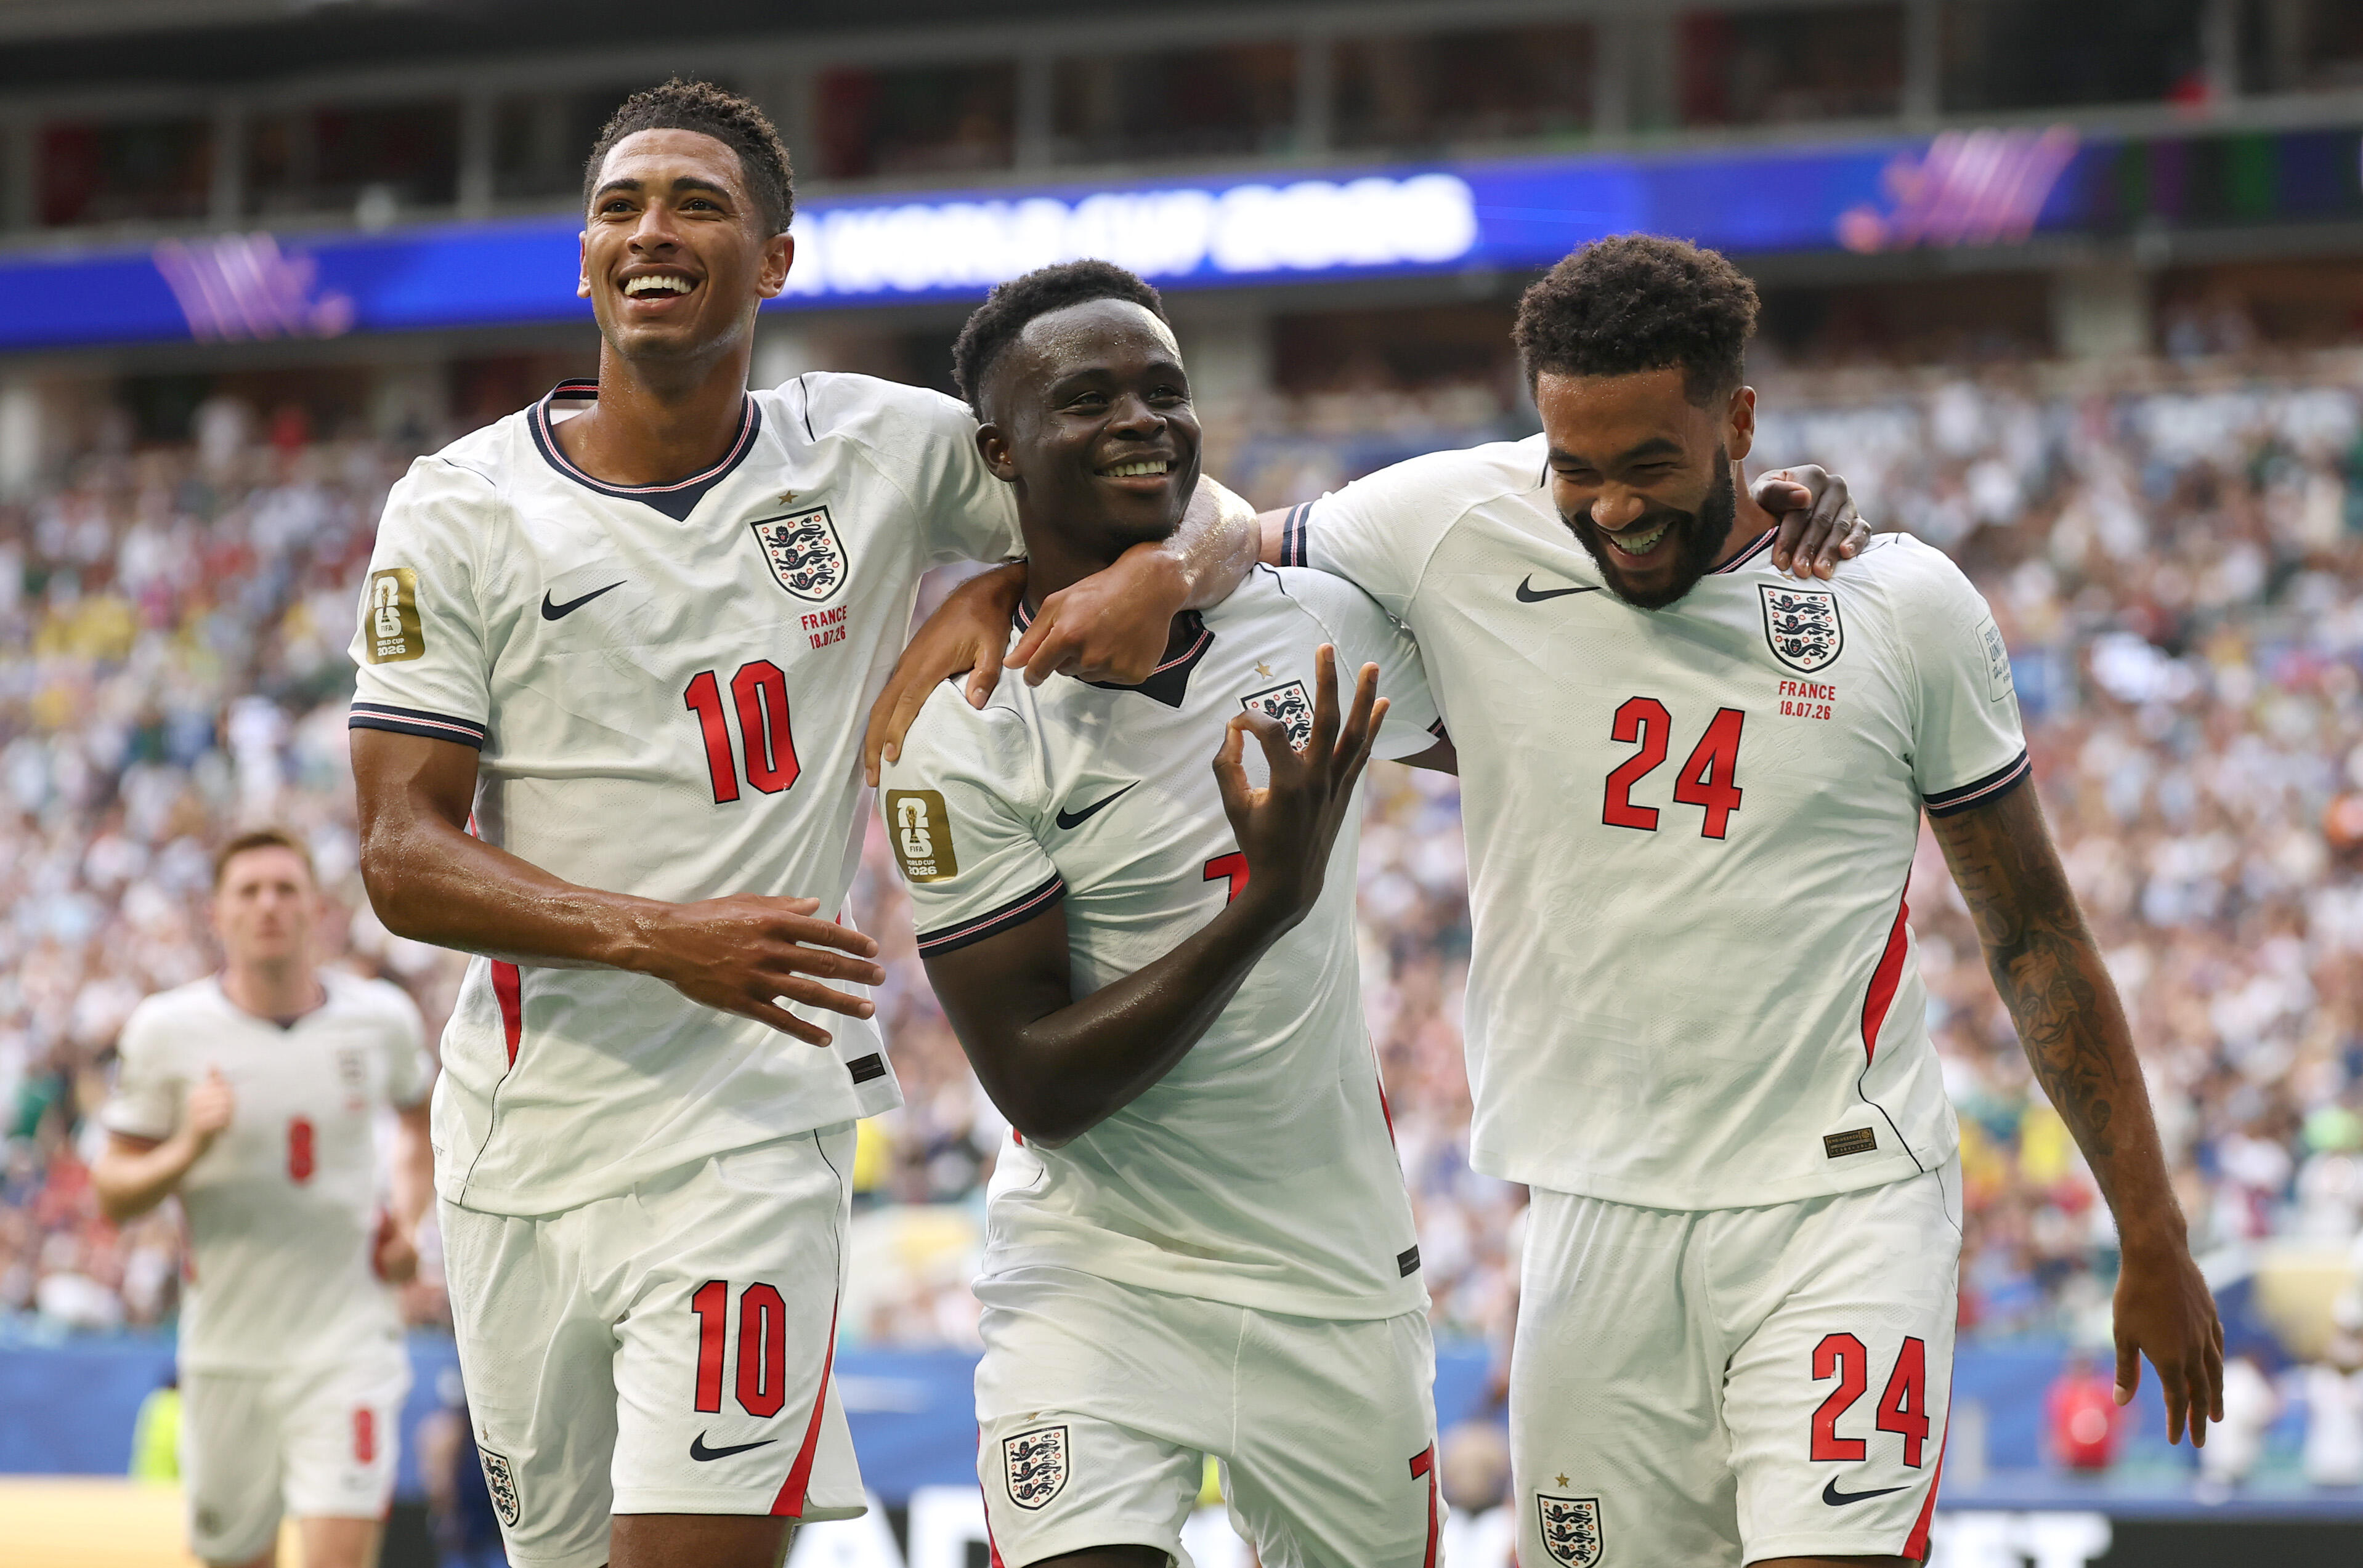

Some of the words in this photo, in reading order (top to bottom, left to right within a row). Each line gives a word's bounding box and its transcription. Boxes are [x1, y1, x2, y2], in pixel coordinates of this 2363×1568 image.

[801, 605, 847, 630] FRANCE
[809, 625, 846, 649] 18.07.26
[378, 645, 405, 656] 2026
[1778, 681, 1836, 701] FRANCE
[1780, 700, 1831, 720] 18.07.26
[684, 659, 801, 804] 10
[1602, 696, 1745, 840] 24
[908, 866, 938, 876] 2026
[691, 1280, 786, 1418] 10
[1810, 1332, 1929, 1469] 24
